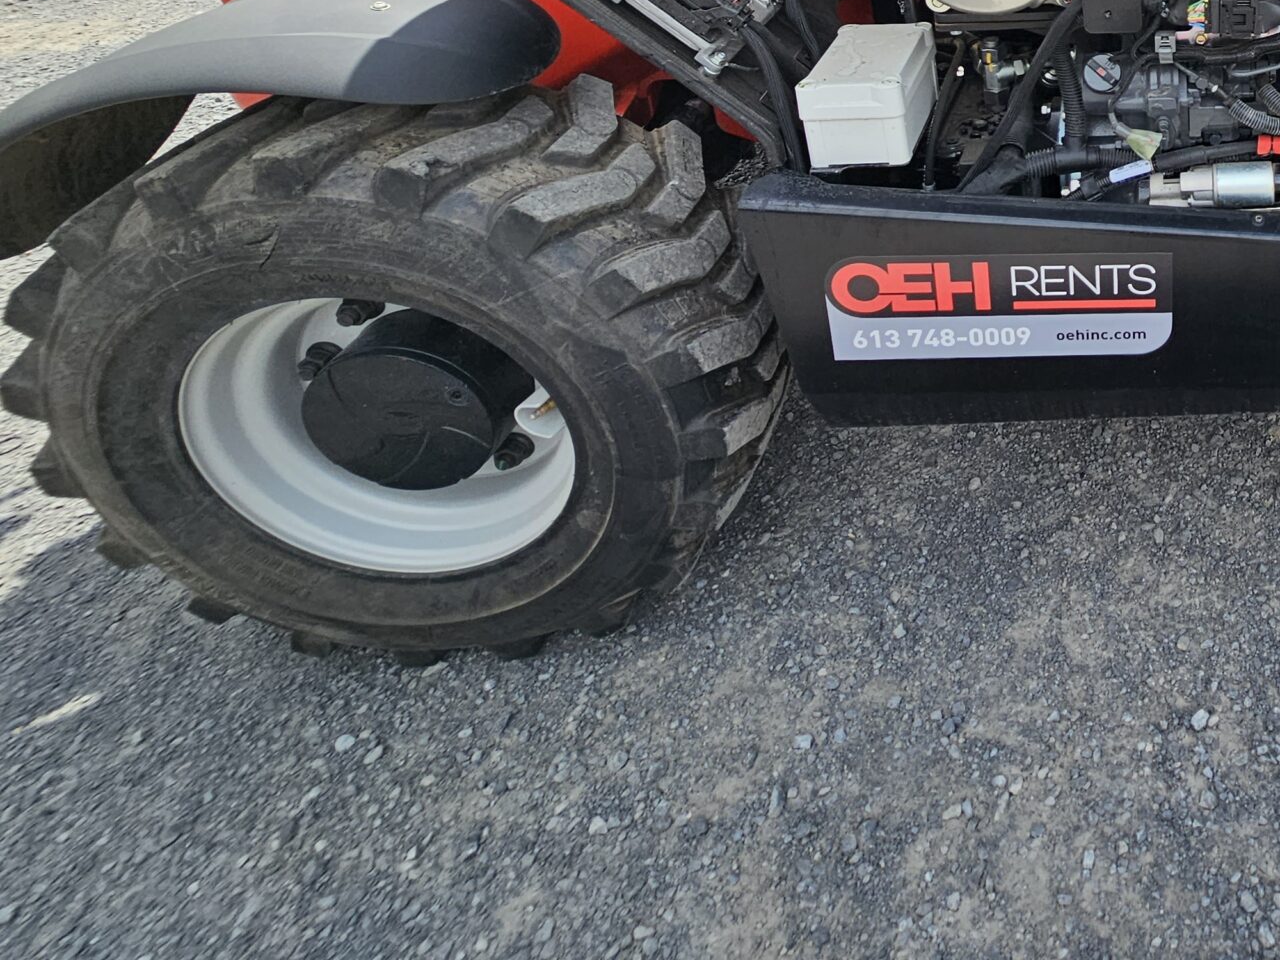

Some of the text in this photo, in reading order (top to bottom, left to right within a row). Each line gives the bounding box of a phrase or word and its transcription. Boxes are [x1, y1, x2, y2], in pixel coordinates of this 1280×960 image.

[831, 261, 1157, 313] OEH RENTS
[853, 327, 1147, 349] 613 748-0009 oehinc.com
